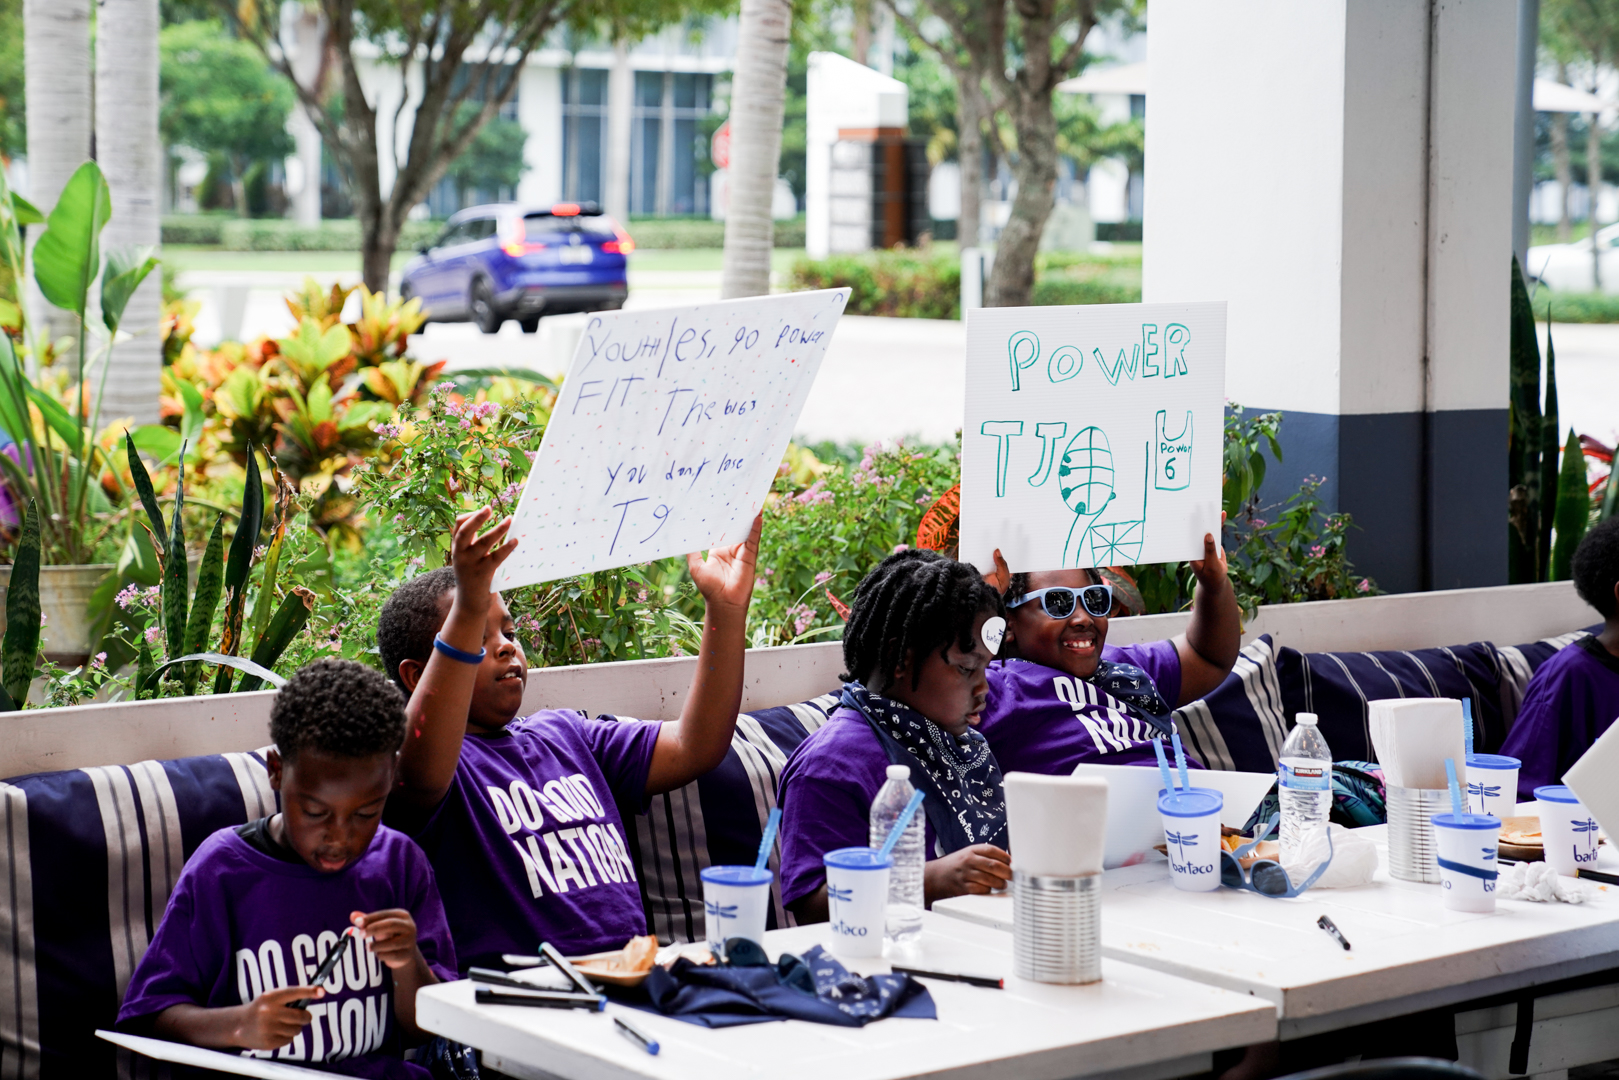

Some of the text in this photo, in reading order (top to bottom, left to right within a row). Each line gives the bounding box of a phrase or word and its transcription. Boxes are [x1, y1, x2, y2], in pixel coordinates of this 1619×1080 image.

[1008, 322, 1191, 392] POWER
[572, 372, 645, 415] FIT
[658, 386, 717, 436] The
[487, 779, 545, 835] DO
[957, 808, 976, 844] bartaco
[513, 822, 638, 899] NATION
[1170, 852, 1214, 875] bartaco
[831, 919, 868, 937] artaco
[235, 925, 384, 1006] DO GOOD
